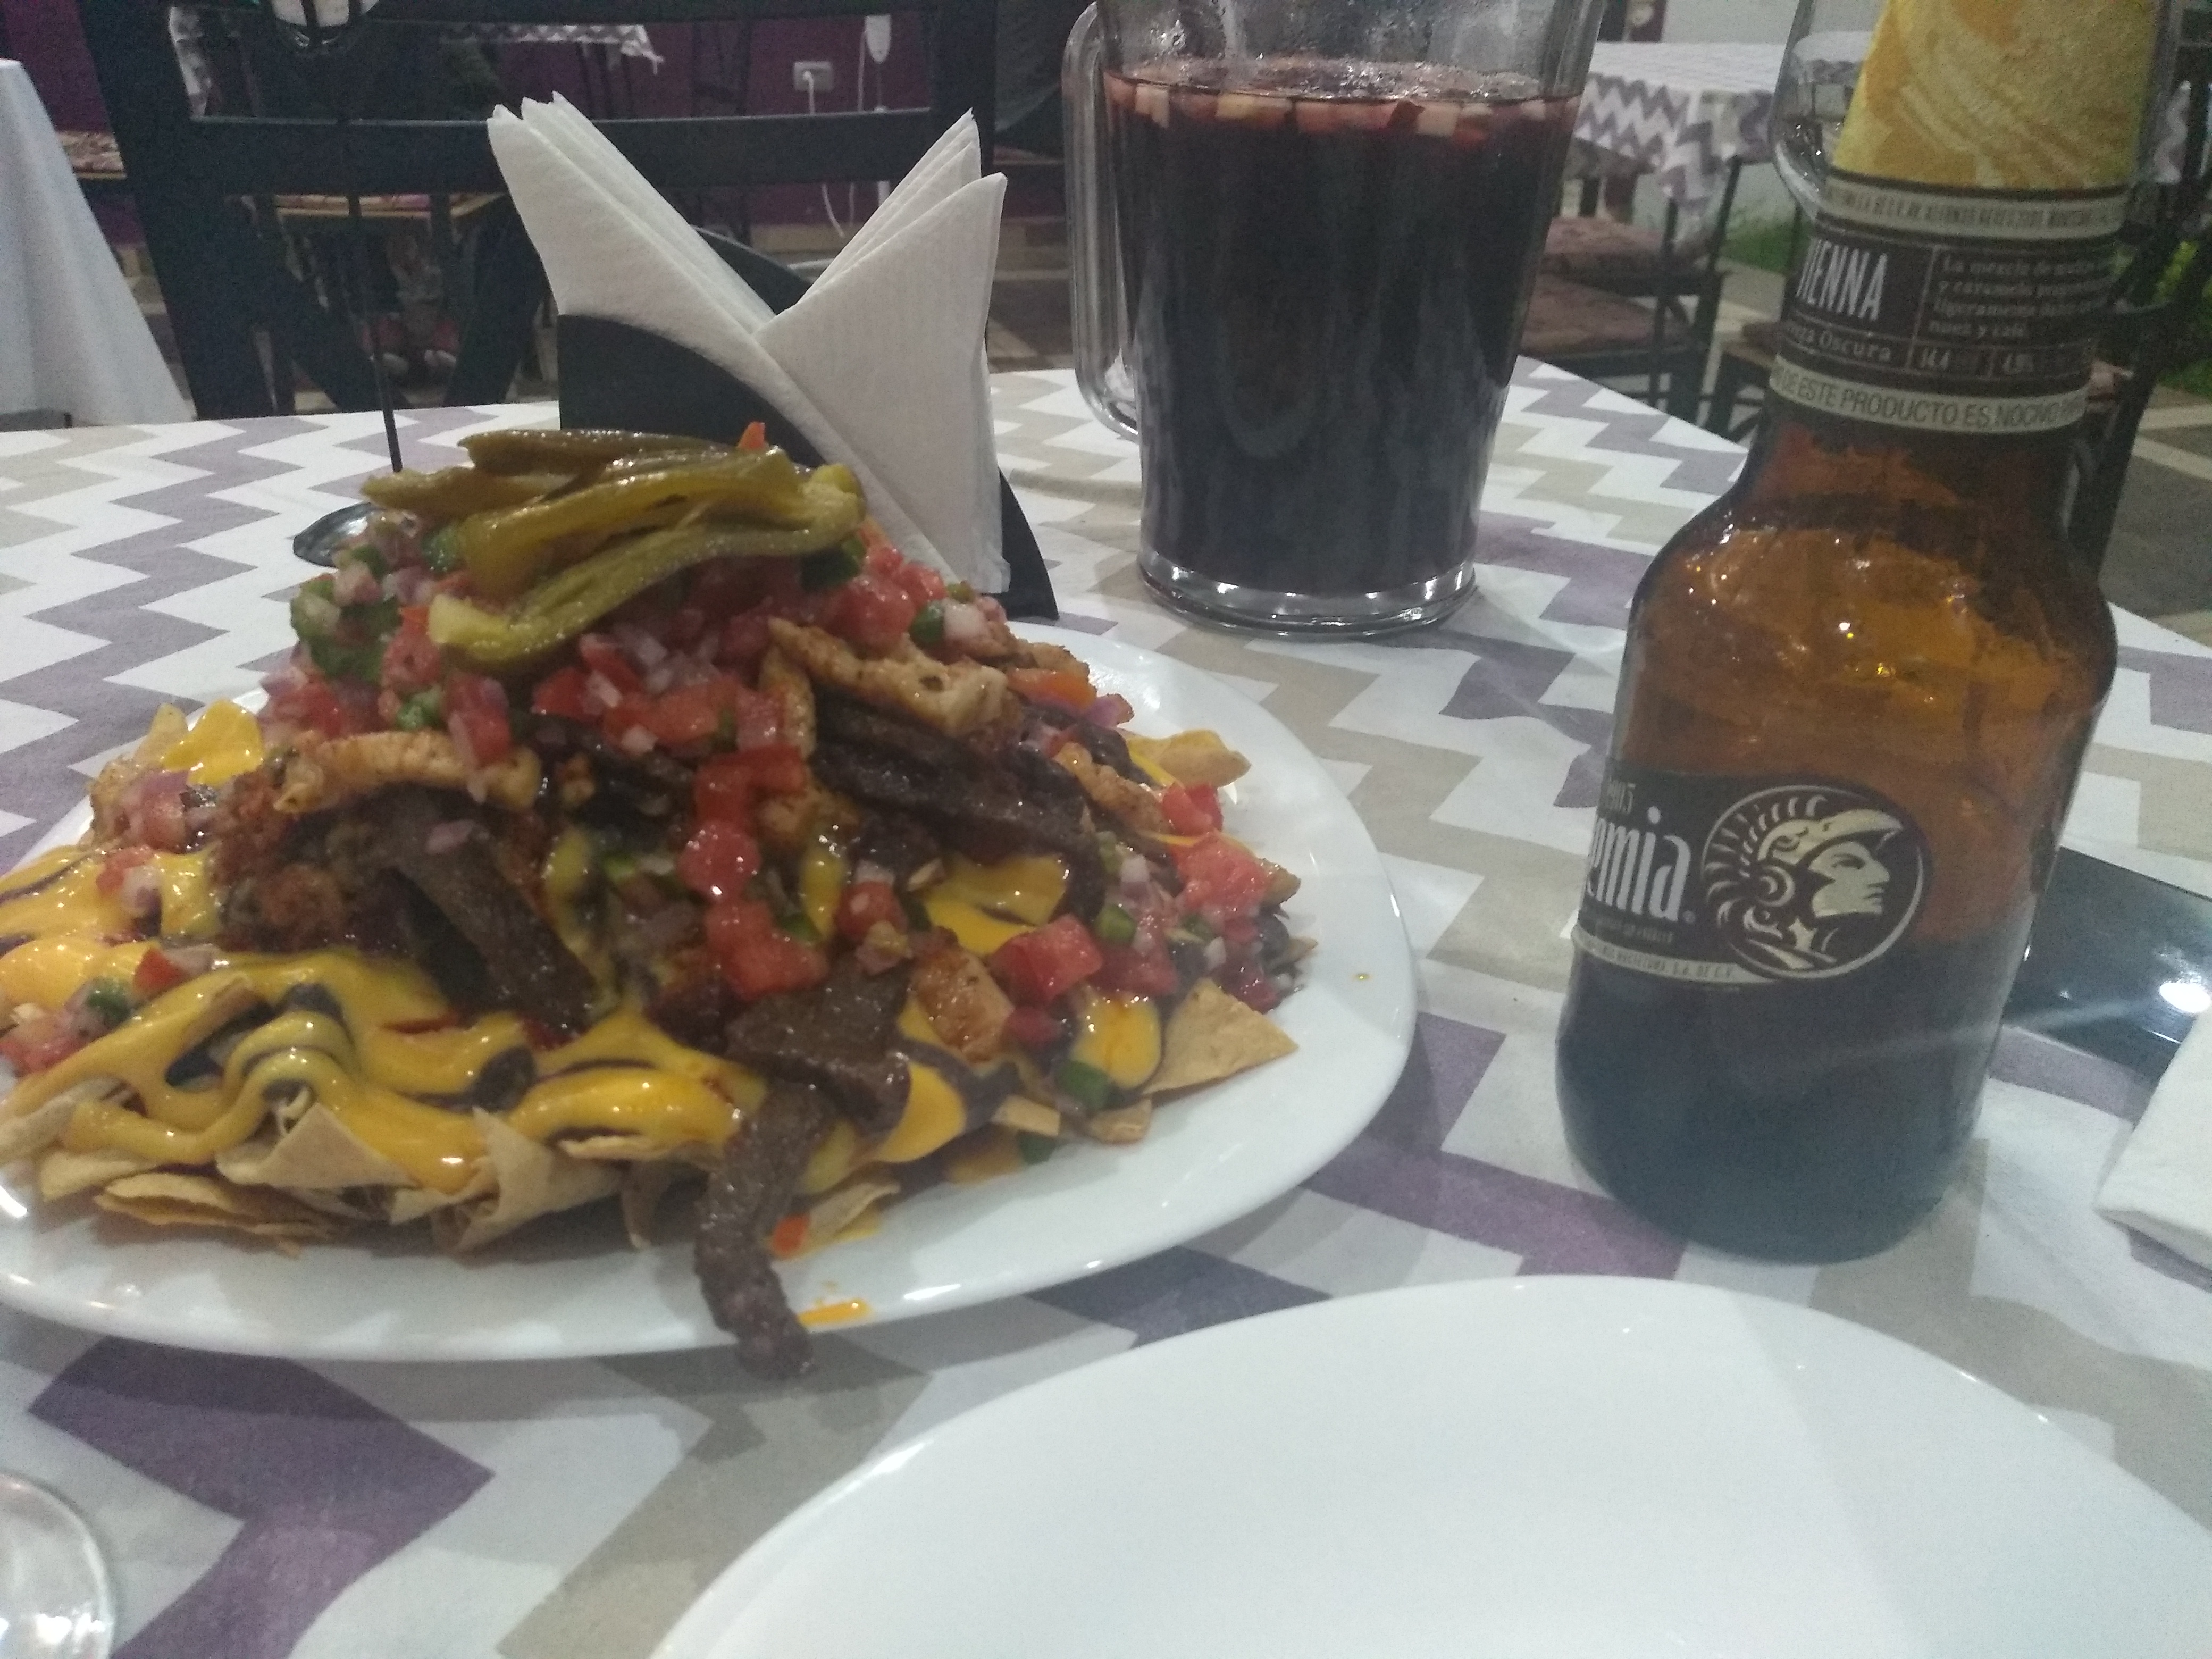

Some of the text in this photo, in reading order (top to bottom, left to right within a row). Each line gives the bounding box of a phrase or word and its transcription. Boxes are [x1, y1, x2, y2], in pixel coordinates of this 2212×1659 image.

[1819, 330, 1891, 362] Oscura
[1797, 378, 1839, 407] ESTE
[1840, 388, 1958, 425] PRODUCTO
[1964, 403, 1990, 426] ES
